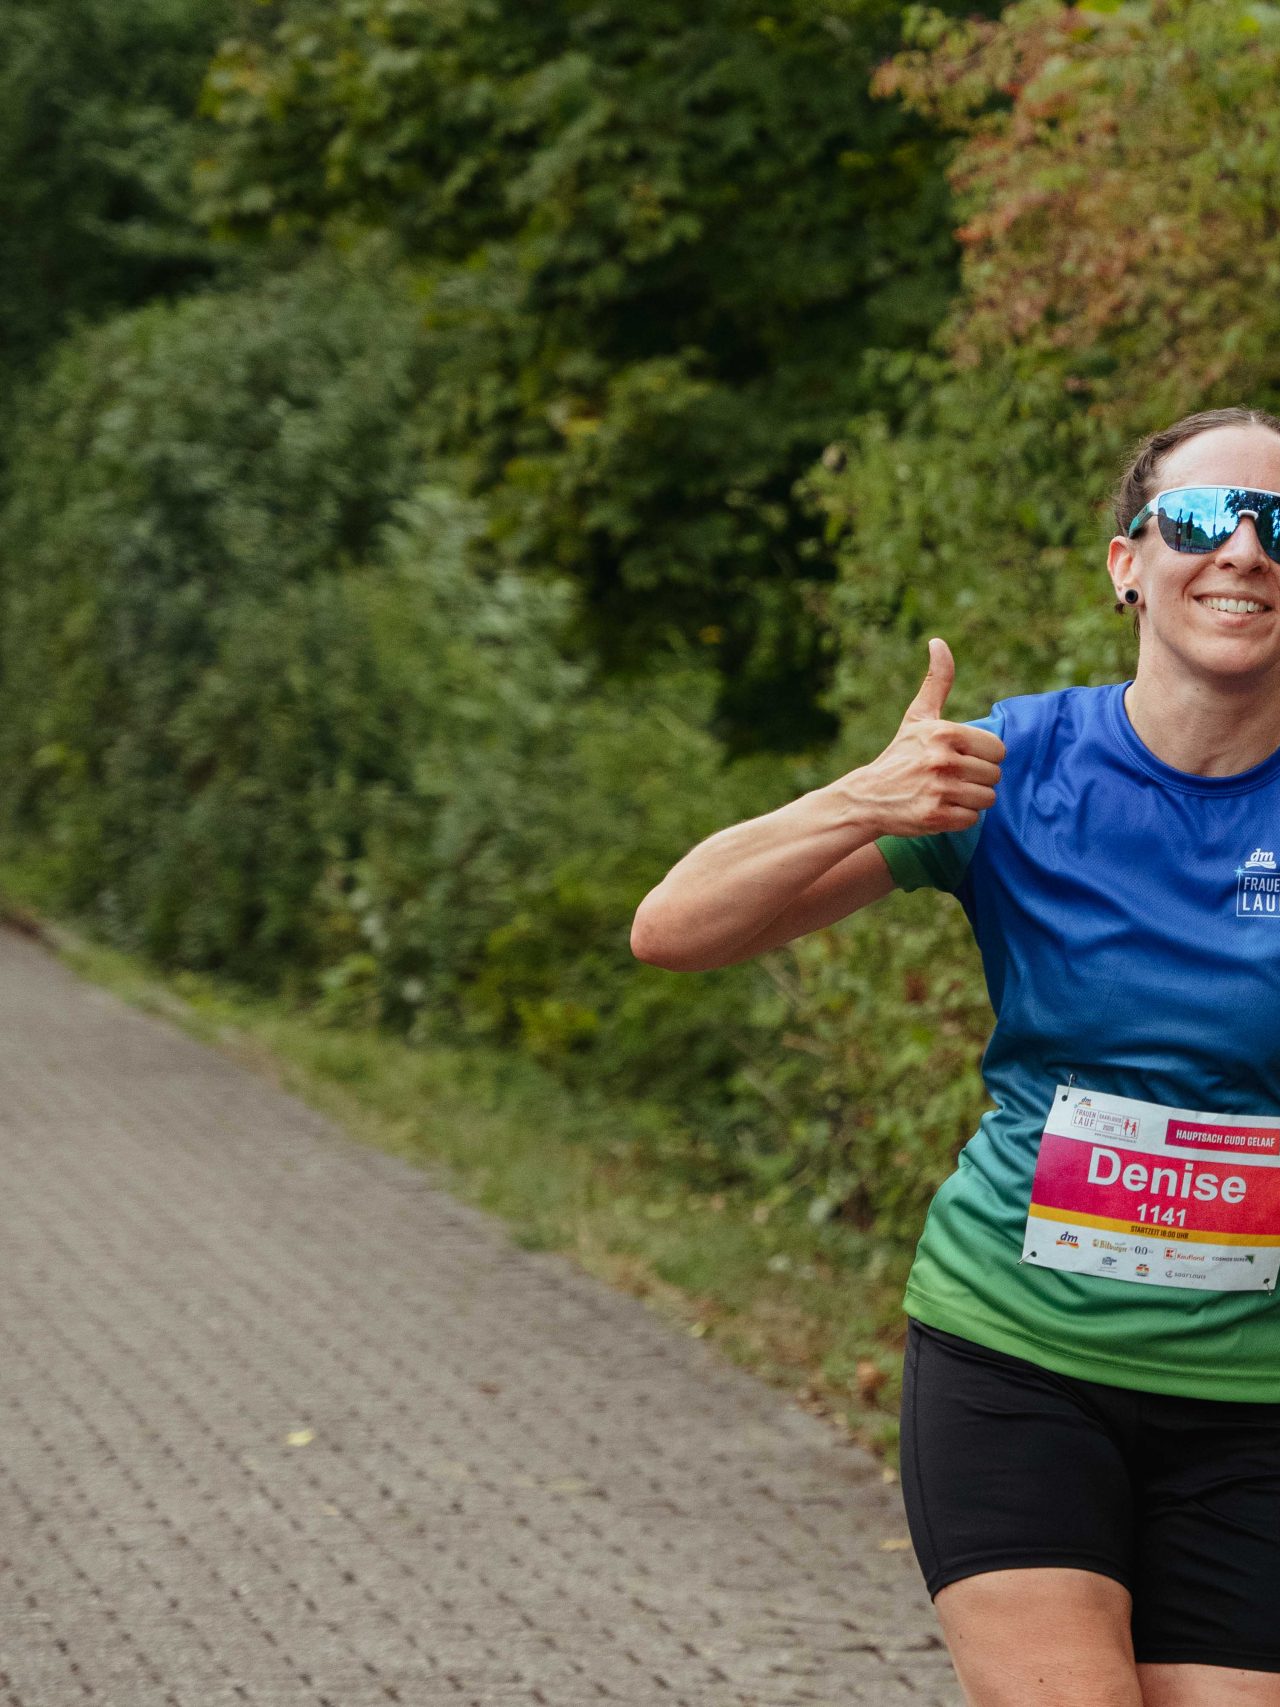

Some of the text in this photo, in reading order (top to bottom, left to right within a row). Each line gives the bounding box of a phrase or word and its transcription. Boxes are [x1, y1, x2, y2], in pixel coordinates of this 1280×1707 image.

[1250, 848, 1274, 862] dm
[1076, 1108, 1096, 1118] FRAUEN
[1074, 1116, 1095, 1128] LAUF
[1176, 1129, 1275, 1148] HAUPTSACH GUDD GELAAF
[1087, 1147, 1247, 1204] Denise
[1136, 1203, 1186, 1227] 1141
[1060, 1231, 1078, 1242] dm
[1130, 1226, 1160, 1236] STARTZEIT
[1176, 1254, 1205, 1262] Kaufland
